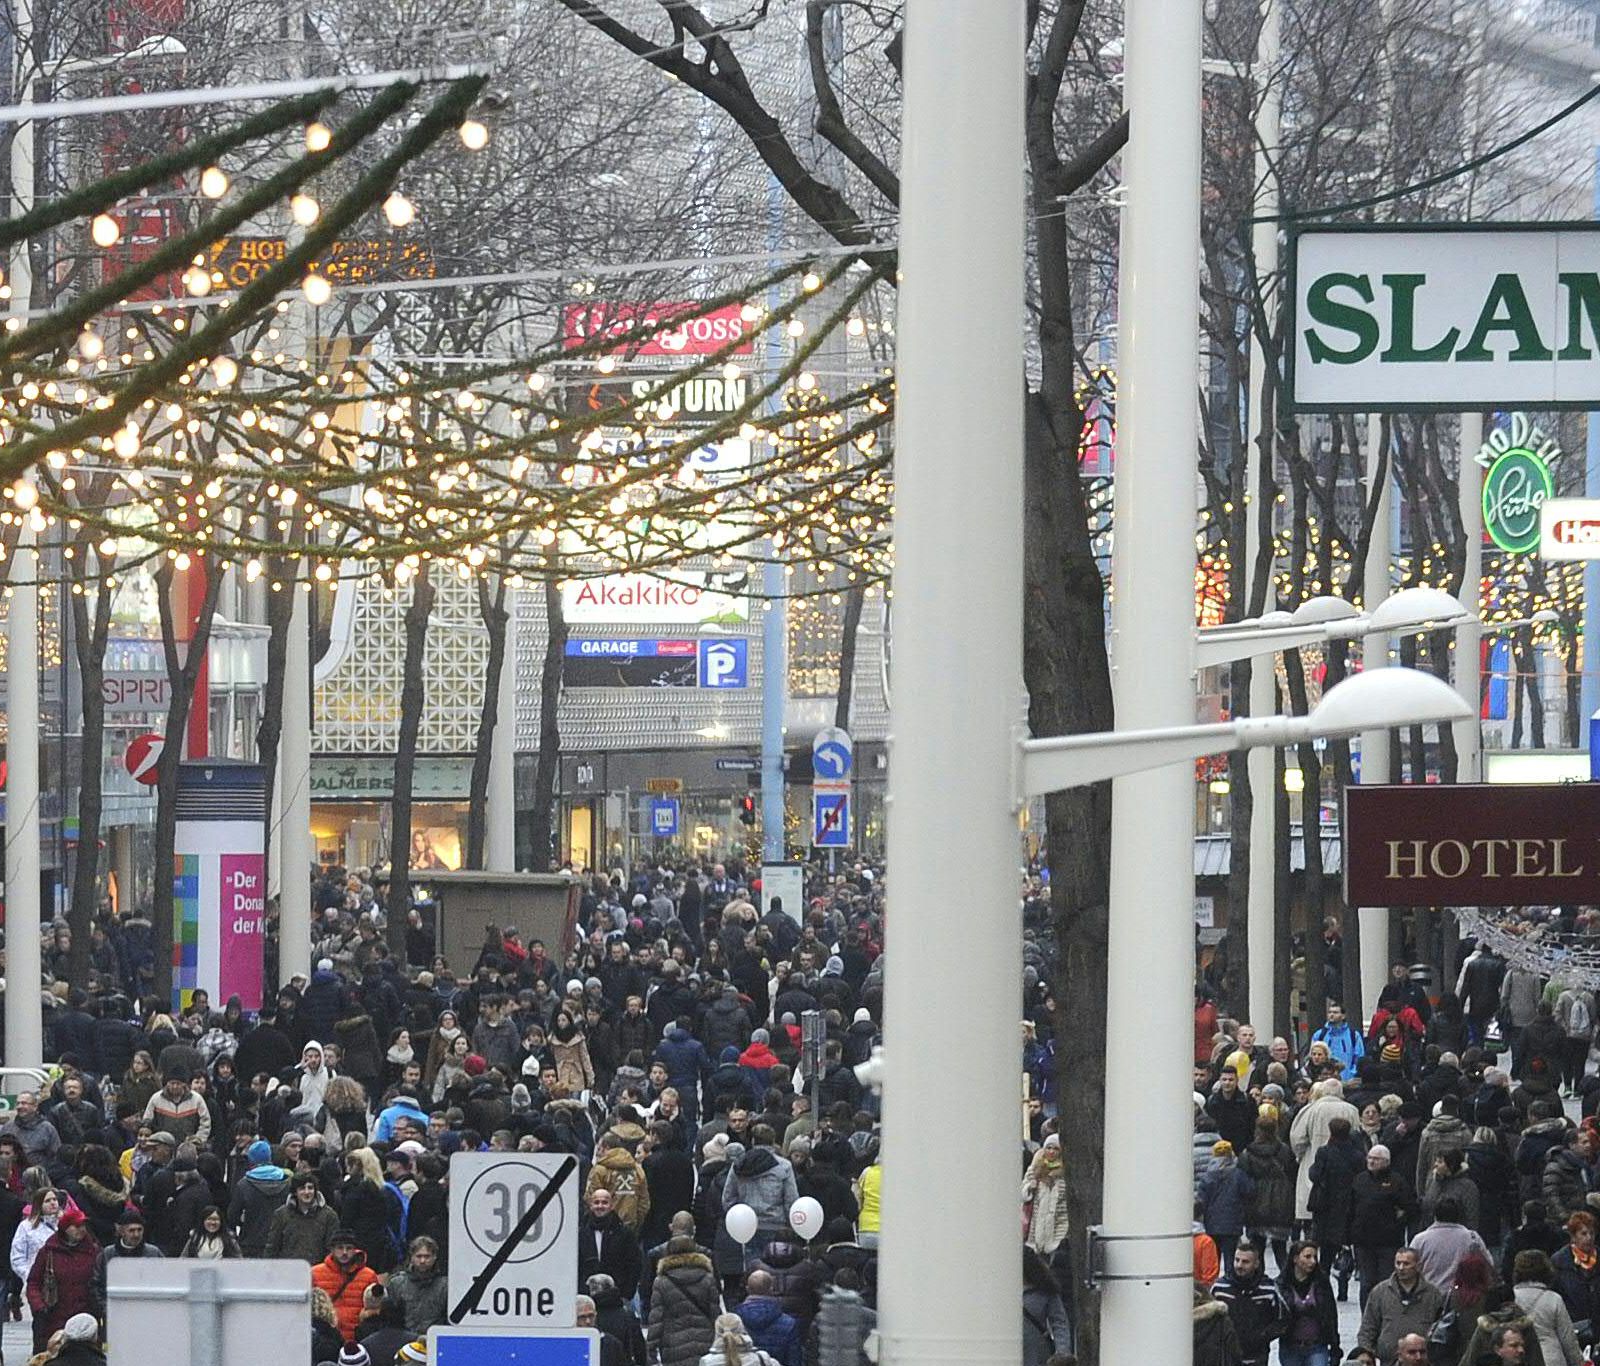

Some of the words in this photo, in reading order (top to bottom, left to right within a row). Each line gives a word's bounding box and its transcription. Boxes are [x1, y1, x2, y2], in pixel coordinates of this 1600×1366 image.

[575, 580, 699, 606] Akakiko
[581, 641, 639, 654] GARAGE
[1384, 837, 1585, 879] HOTEL
[484, 1182, 544, 1243] 30
